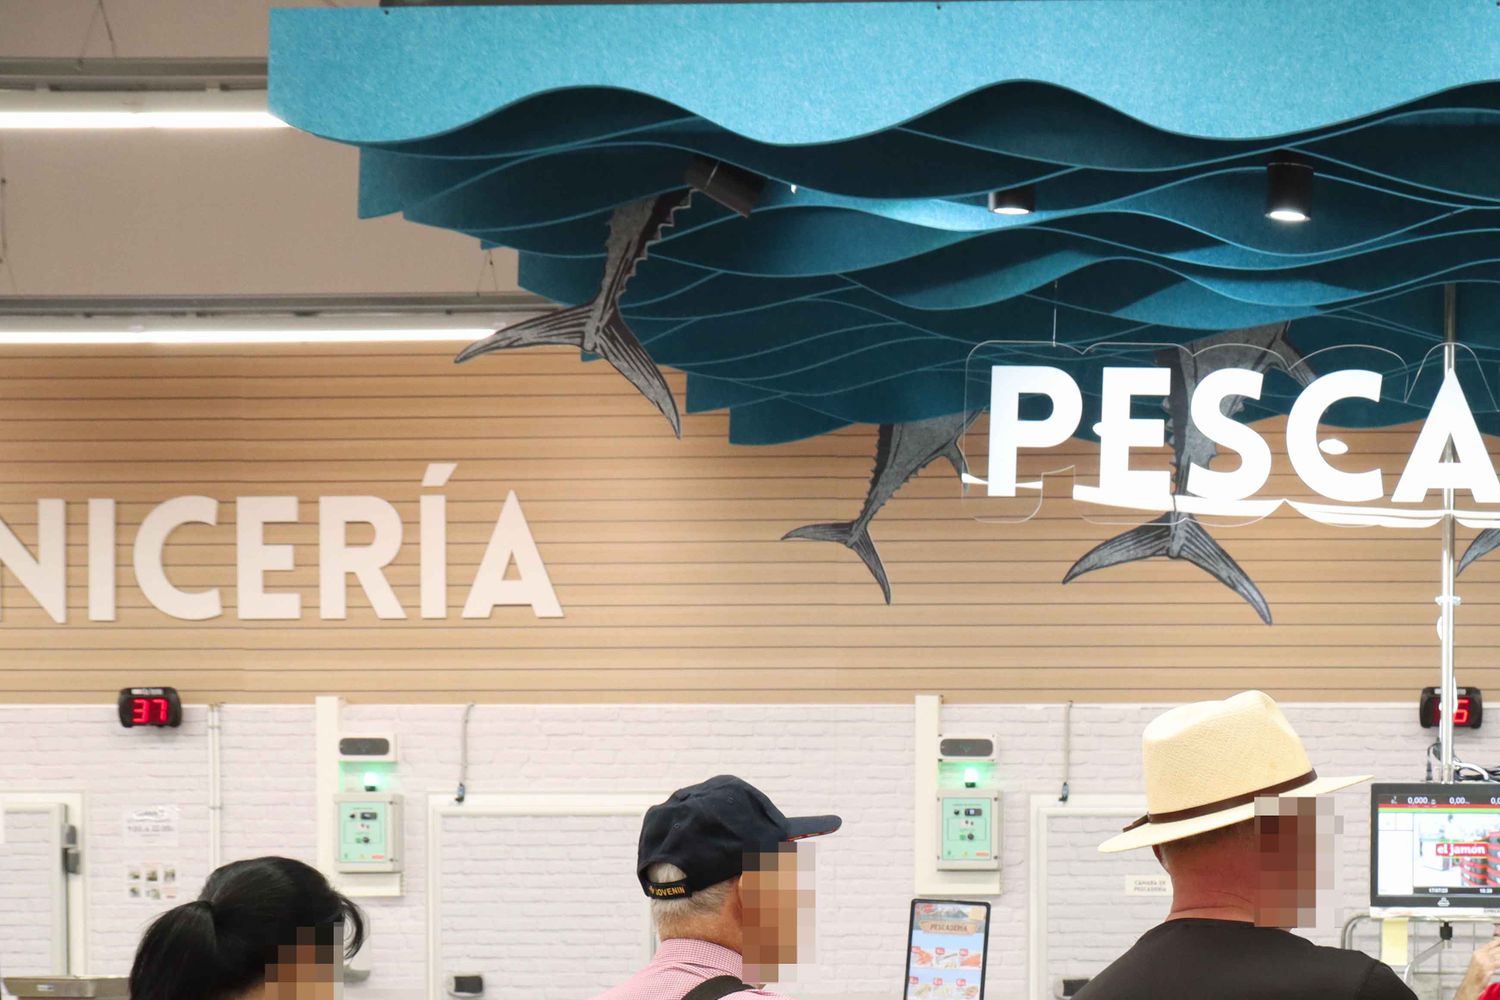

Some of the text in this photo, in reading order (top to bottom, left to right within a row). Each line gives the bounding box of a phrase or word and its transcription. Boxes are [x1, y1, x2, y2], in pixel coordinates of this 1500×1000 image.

[0, 463, 565, 624] NICERÍA
[133, 698, 168, 723] 37
[1436, 843, 1486, 856] el jamón
